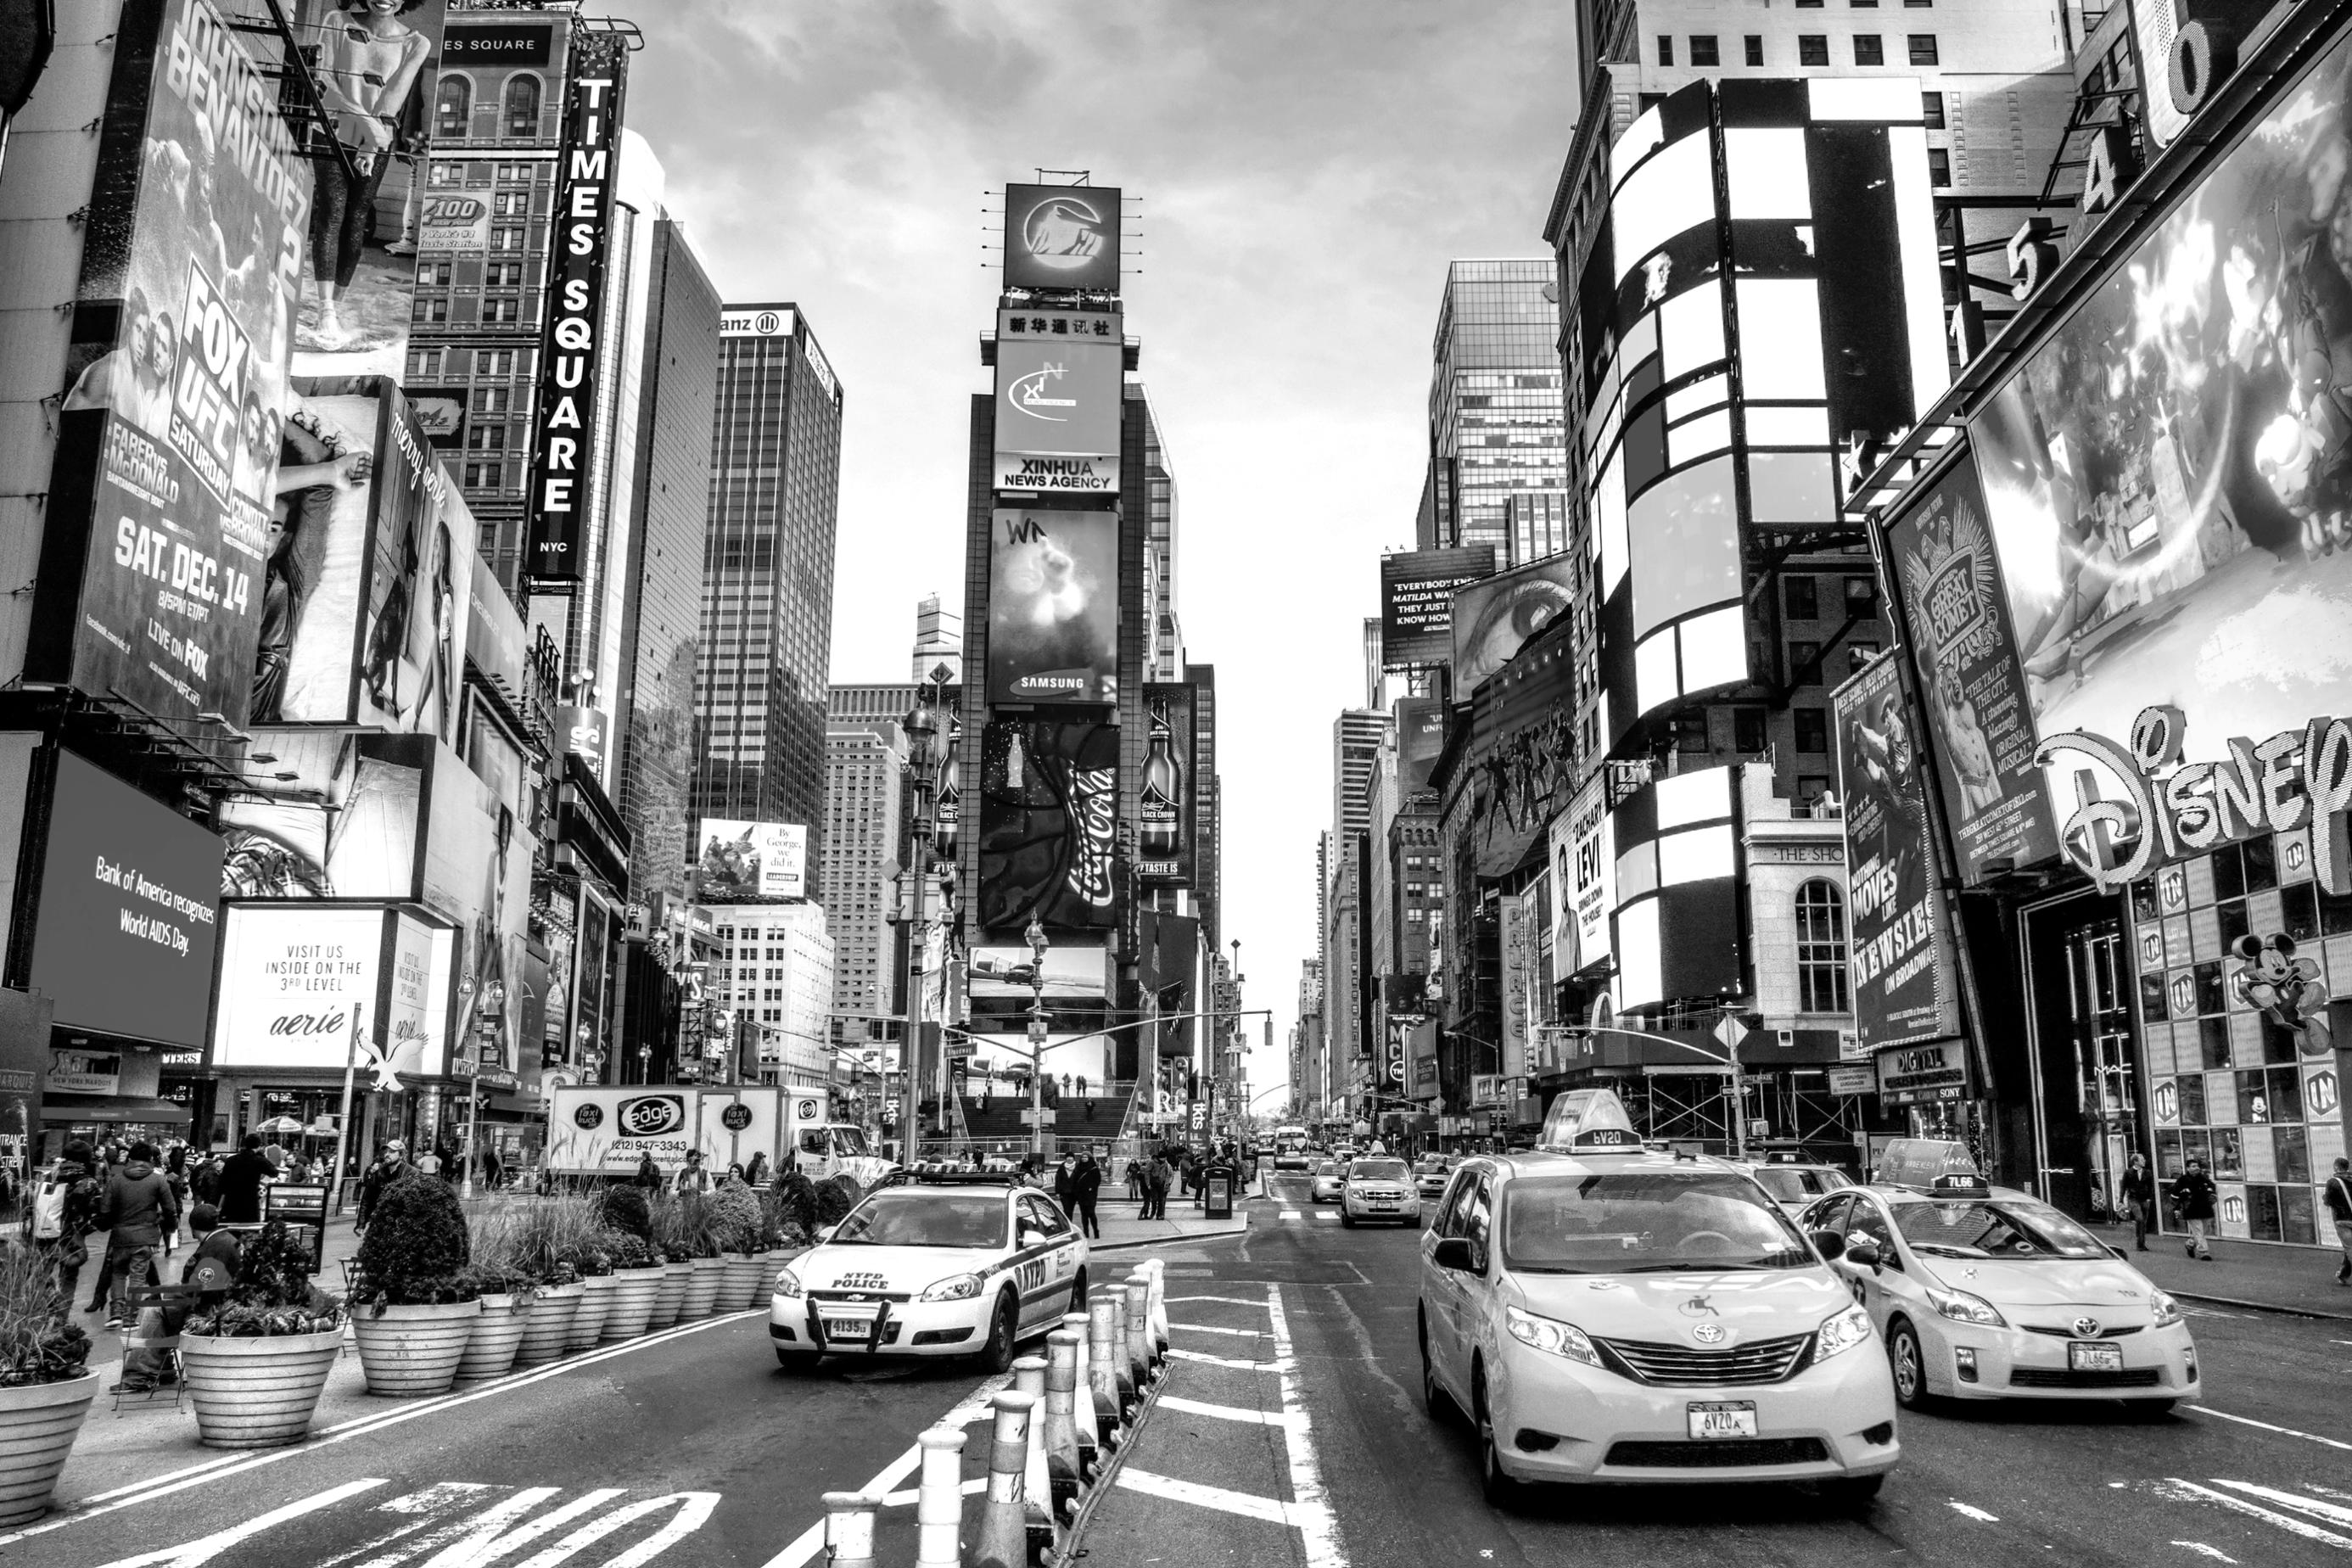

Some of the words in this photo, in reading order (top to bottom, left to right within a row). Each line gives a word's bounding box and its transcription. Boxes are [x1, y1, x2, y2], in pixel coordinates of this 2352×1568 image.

[470, 40, 535, 51] SQUARE
[168, 28, 307, 226] BENAVIDEZ
[568, 79, 613, 255] TIMES
[279, 224, 301, 303] 2
[183, 262, 248, 409] FOX
[1010, 316, 1110, 336] 新华通讯社
[544, 278, 591, 512] SQUARE
[177, 356, 237, 461] UFC
[112, 422, 154, 462] FABER
[391, 412, 423, 490] merry
[171, 414, 231, 498] SATURDAY
[109, 445, 179, 505] McDONALD
[1021, 458, 1095, 476] XINHUA
[1005, 474, 1047, 487] NEWS
[1050, 476, 1112, 489] AGENCY
[540, 542, 568, 552] NYC
[115, 515, 167, 582] SAT.
[171, 535, 220, 606] DEC.
[224, 566, 249, 615] 14
[1392, 593, 1432, 603] MATILDA
[1930, 567, 1969, 621] GREAT
[1398, 604, 1423, 613] THEY
[1424, 602, 1446, 612] JUST
[1934, 589, 1976, 645] COMET
[1397, 615, 1427, 625] KNOW
[1429, 613, 1451, 623] HOW
[148, 617, 171, 652] LIVE
[171, 637, 184, 663] ON
[184, 637, 210, 682] FOX
[1982, 662, 2002, 687] TALK
[2002, 655, 2011, 673] OF
[1021, 676, 1084, 689] SAMSUNG
[1975, 689, 1991, 710] THE
[1981, 711, 1987, 726] A
[1996, 725, 2030, 757] ORIGINAL
[766, 837, 801, 849] George,
[779, 827, 790, 839] By
[770, 857, 786, 867] did
[1576, 832, 1601, 893] LEVI
[1779, 848, 1806, 861] THE
[767, 872, 798, 881] LEADERSHIP
[1169, 862, 1178, 873] IS
[1851, 852, 1881, 891] NOTHING
[95, 855, 122, 888] Bank
[122, 868, 137, 892] of
[136, 872, 172, 907] America
[172, 893, 215, 925] recognizes
[1851, 858, 1898, 927] MOVES
[1881, 894, 1897, 922] LIKE
[120, 907, 148, 938] World
[148, 919, 171, 946] AIDS
[172, 927, 189, 957] Day.
[1853, 893, 1935, 989] NEWSIES
[287, 945, 321, 958] VISIT
[326, 945, 344, 958] US
[266, 961, 310, 975] INSIDE
[315, 961, 333, 974] ON
[339, 961, 362, 975] THE
[1508, 907, 1524, 1038] PALACE
[305, 977, 344, 991] LEVEL
[1884, 974, 1896, 996] ON
[269, 1005, 344, 1036] aerie
[947, 1045, 972, 1056] Broadway
[1897, 1048, 1943, 1073] DIGITAL
[0, 1073, 35, 1089] ARQUIS
[53, 1076, 66, 1084] NEW
[68, 1078, 83, 1086] YORK
[1940, 1087, 1960, 1098] SONY
[578, 1116, 597, 1124] truck
[580, 1108, 599, 1117] taxi
[631, 1105, 672, 1126] edge
[727, 1108, 748, 1118] taxi
[886, 1099, 899, 1126] tkts
[1192, 1102, 1207, 1130] tkts
[612, 1140, 634, 1151] (212)
[636, 1140, 687, 1151] 947-3343
[1948, 1176, 1974, 1188] 7L66
[832, 1280, 889, 1290] POLICE
[1022, 1258, 1046, 1292] NYPD
[833, 1320, 860, 1333] 4135
[1705, 1412, 1732, 1430] 6V20
[1733, 1420, 1741, 1430] A
